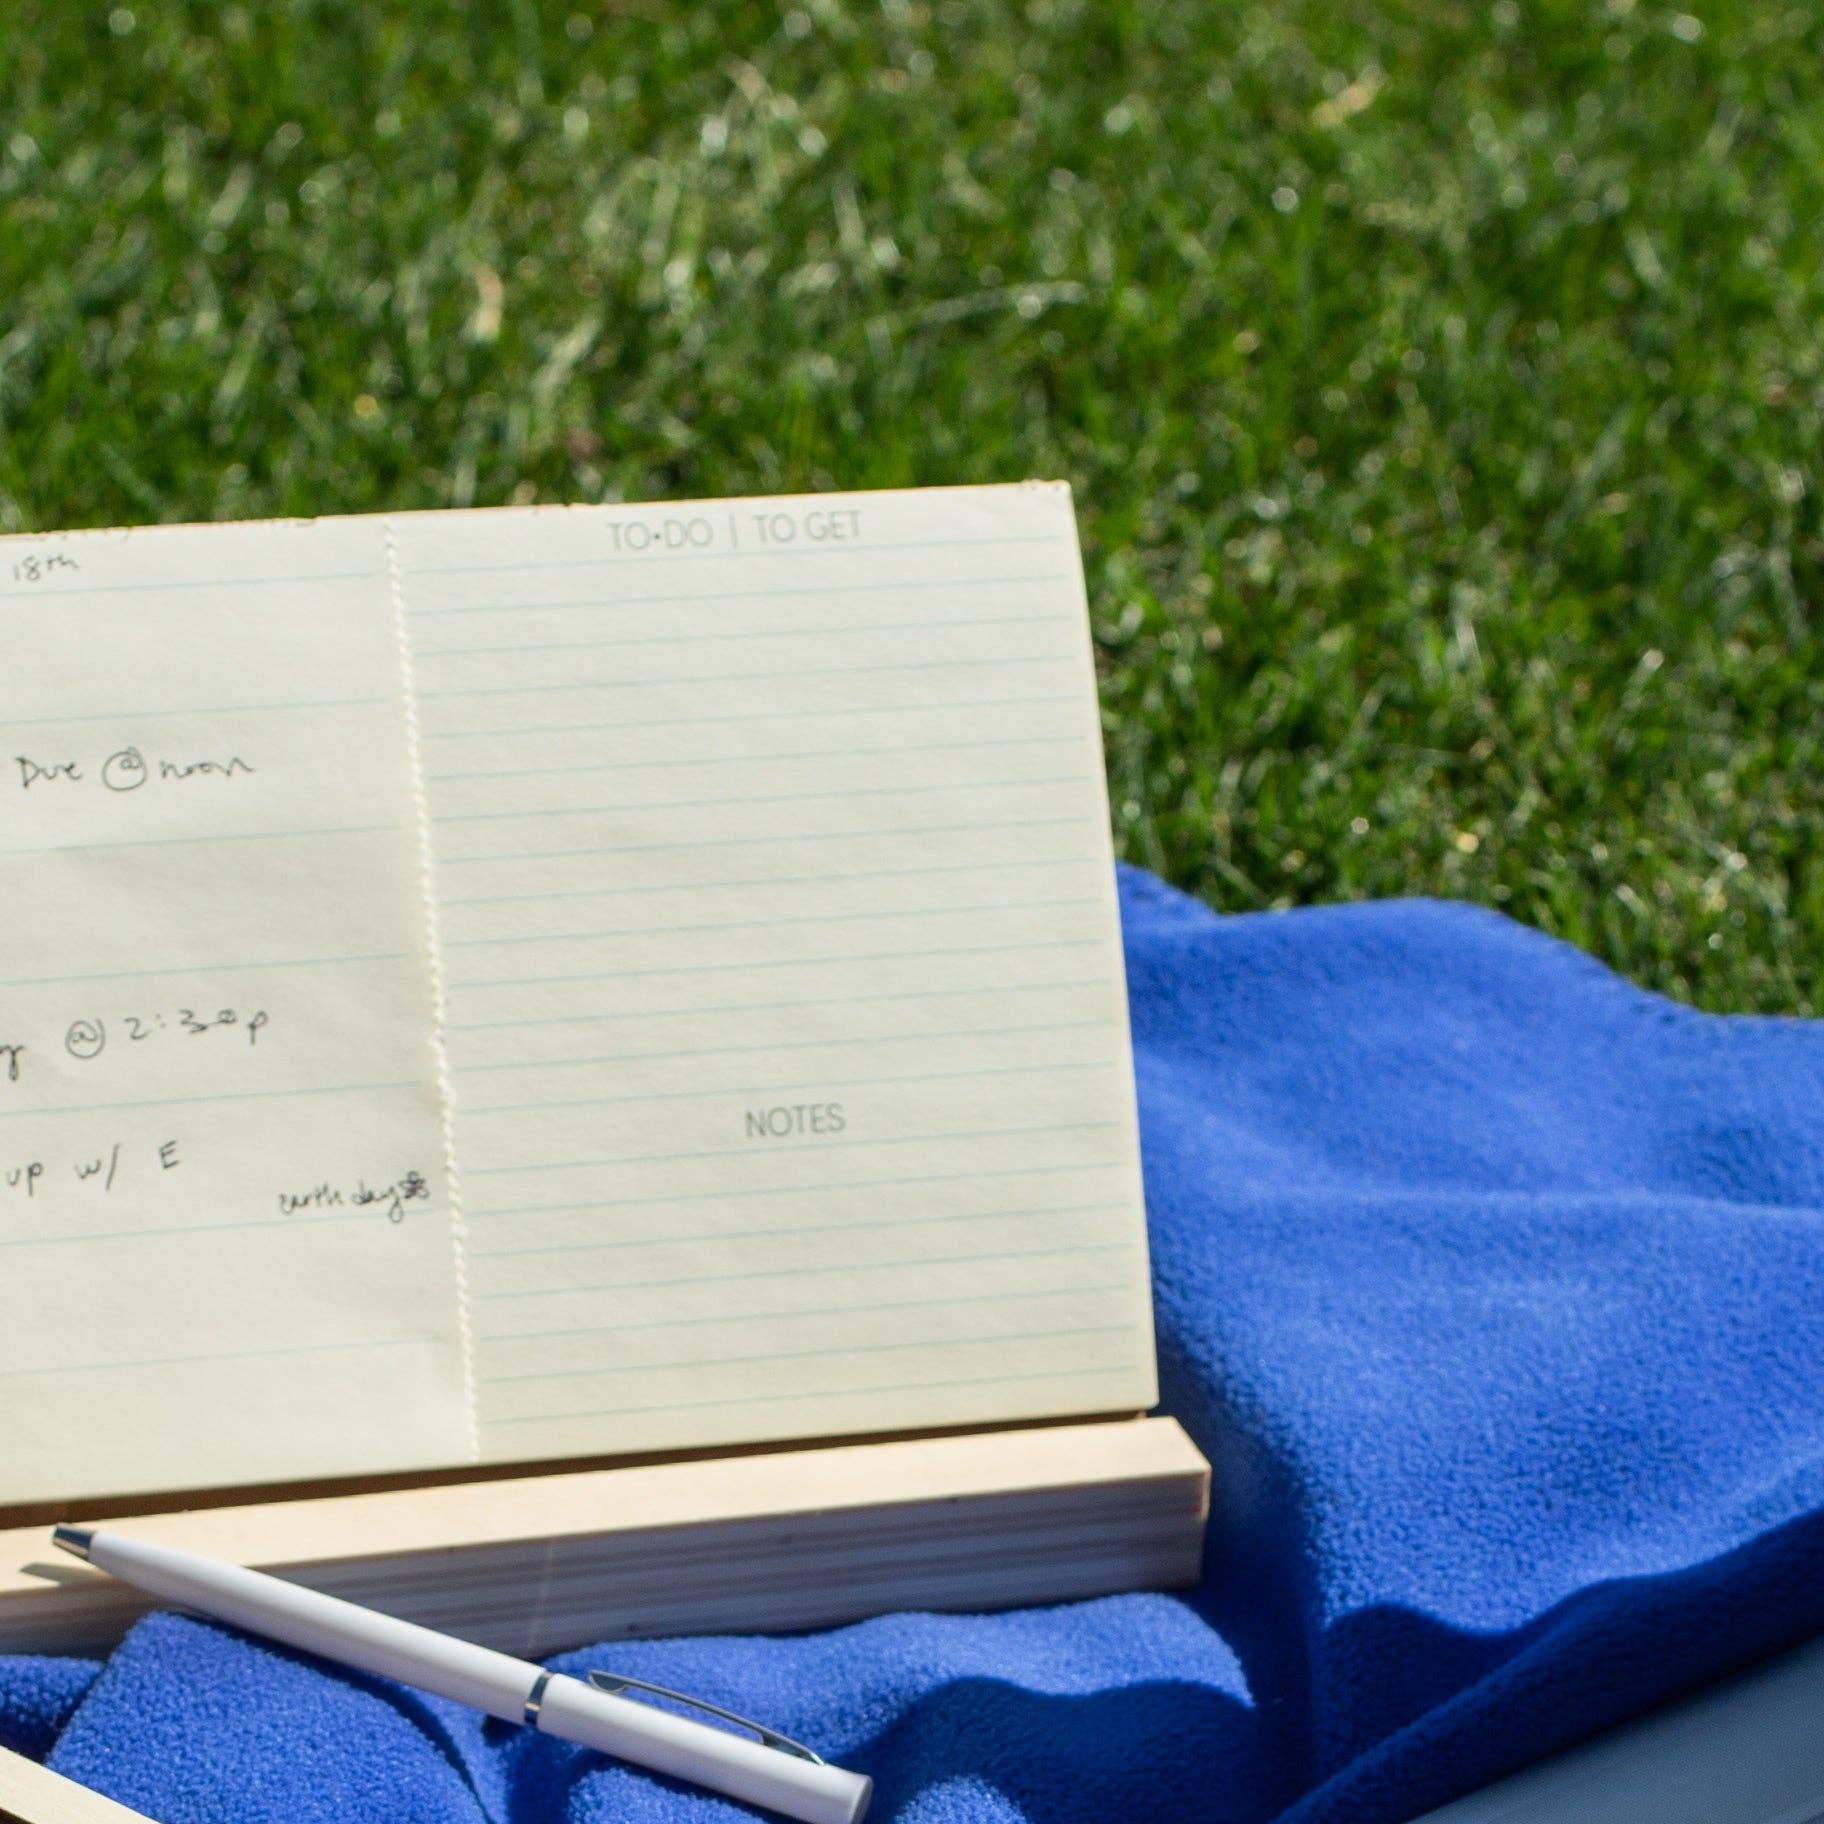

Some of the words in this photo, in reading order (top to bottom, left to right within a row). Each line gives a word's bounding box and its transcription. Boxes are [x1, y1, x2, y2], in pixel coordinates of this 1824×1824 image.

[751, 513, 798, 544] TO
[805, 508, 862, 542] GET
[18, 755, 84, 789] Due
[744, 1103, 846, 1139] NOTES
[4, 1160, 46, 1198] up
[73, 1142, 122, 1191] w/
[158, 1140, 181, 1171] E
